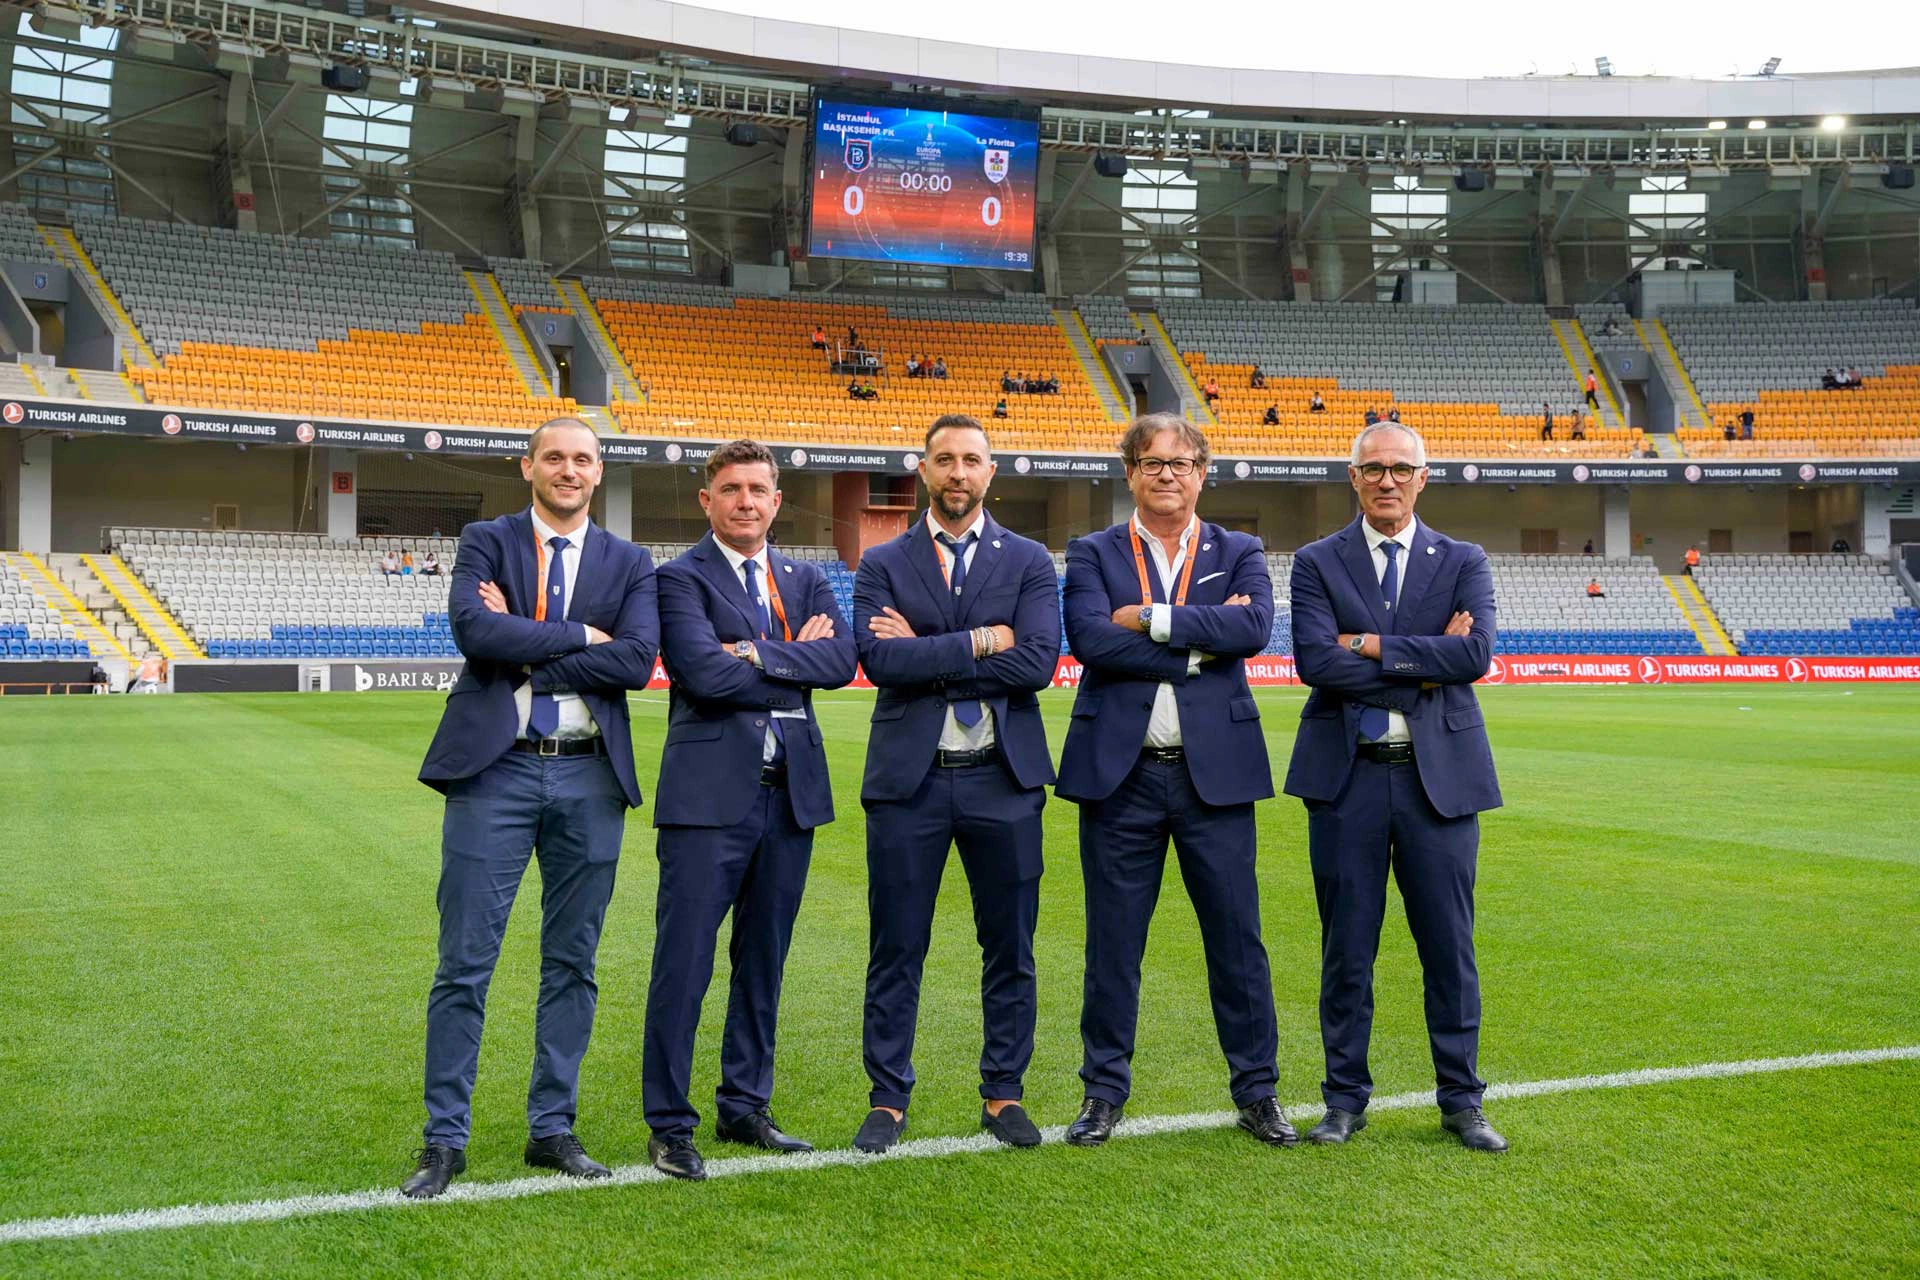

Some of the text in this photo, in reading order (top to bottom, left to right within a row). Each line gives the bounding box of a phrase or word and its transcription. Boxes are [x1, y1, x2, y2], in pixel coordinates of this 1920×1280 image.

[837, 112, 882, 124] İSTANBUL
[883, 128, 895, 136] FK
[976, 137, 1016, 147] La Fiorita
[900, 172, 952, 192] 00:00
[843, 185, 864, 216] 0
[981, 196, 1002, 226] 0
[1004, 251, 1028, 262] 19:39
[28, 409, 127, 426] TURKISH AIRLINES
[185, 421, 277, 436] TURKISH AIRLINES
[318, 429, 405, 443] TURKISH AIRLINES
[445, 437, 529, 450] TURKISH AIRLINES
[608, 445, 648, 456] AIRLINES
[810, 454, 886, 465] TURKISH AIRLINES
[1033, 461, 1108, 472] TURKISH AIRLINES
[1253, 466, 1327, 475] TURKISH AIRLINES
[1704, 468, 1782, 477] TURKISH AIRLINES
[1818, 467, 1898, 476] TURKISH AIRLINES
[1481, 468, 1556, 478] TURKISH AIRLINES
[1591, 469, 1668, 478] TURKISH AIRLINES
[1510, 663, 1631, 677] TURKISH AIRLINES
[1665, 664, 1779, 677] TURKISH AIRLINES
[1811, 665, 1920, 678] TURKISH AIRLINES
[377, 672, 416, 687] BARI
[422, 672, 434, 686] &
